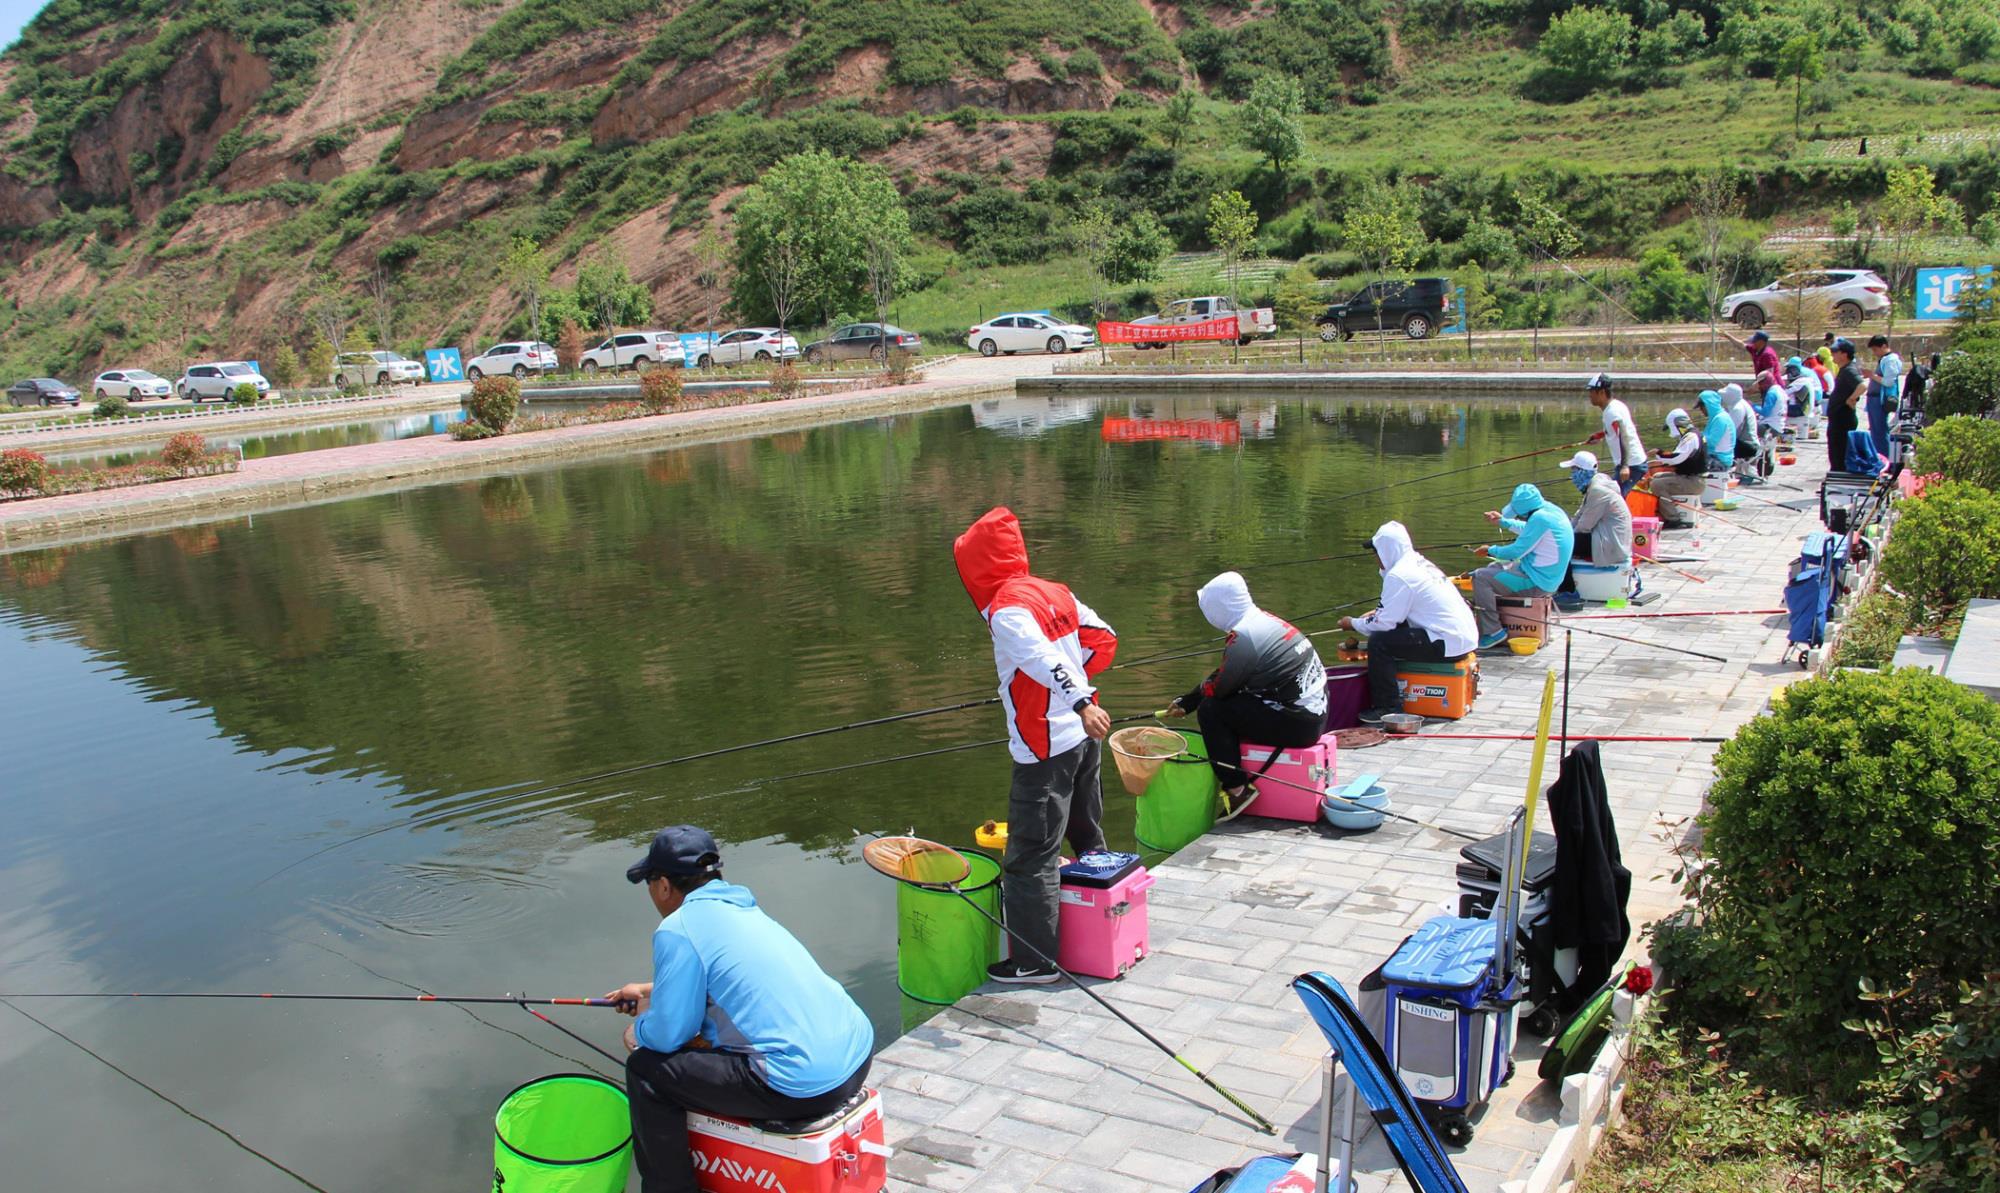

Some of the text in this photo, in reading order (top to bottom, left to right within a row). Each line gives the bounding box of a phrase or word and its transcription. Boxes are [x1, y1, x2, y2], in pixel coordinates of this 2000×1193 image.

[431, 352, 459, 379] 水
[1508, 623, 1537, 632] UKYU
[1412, 687, 1445, 697] WOTION
[1405, 1003, 1448, 1020] FISHING
